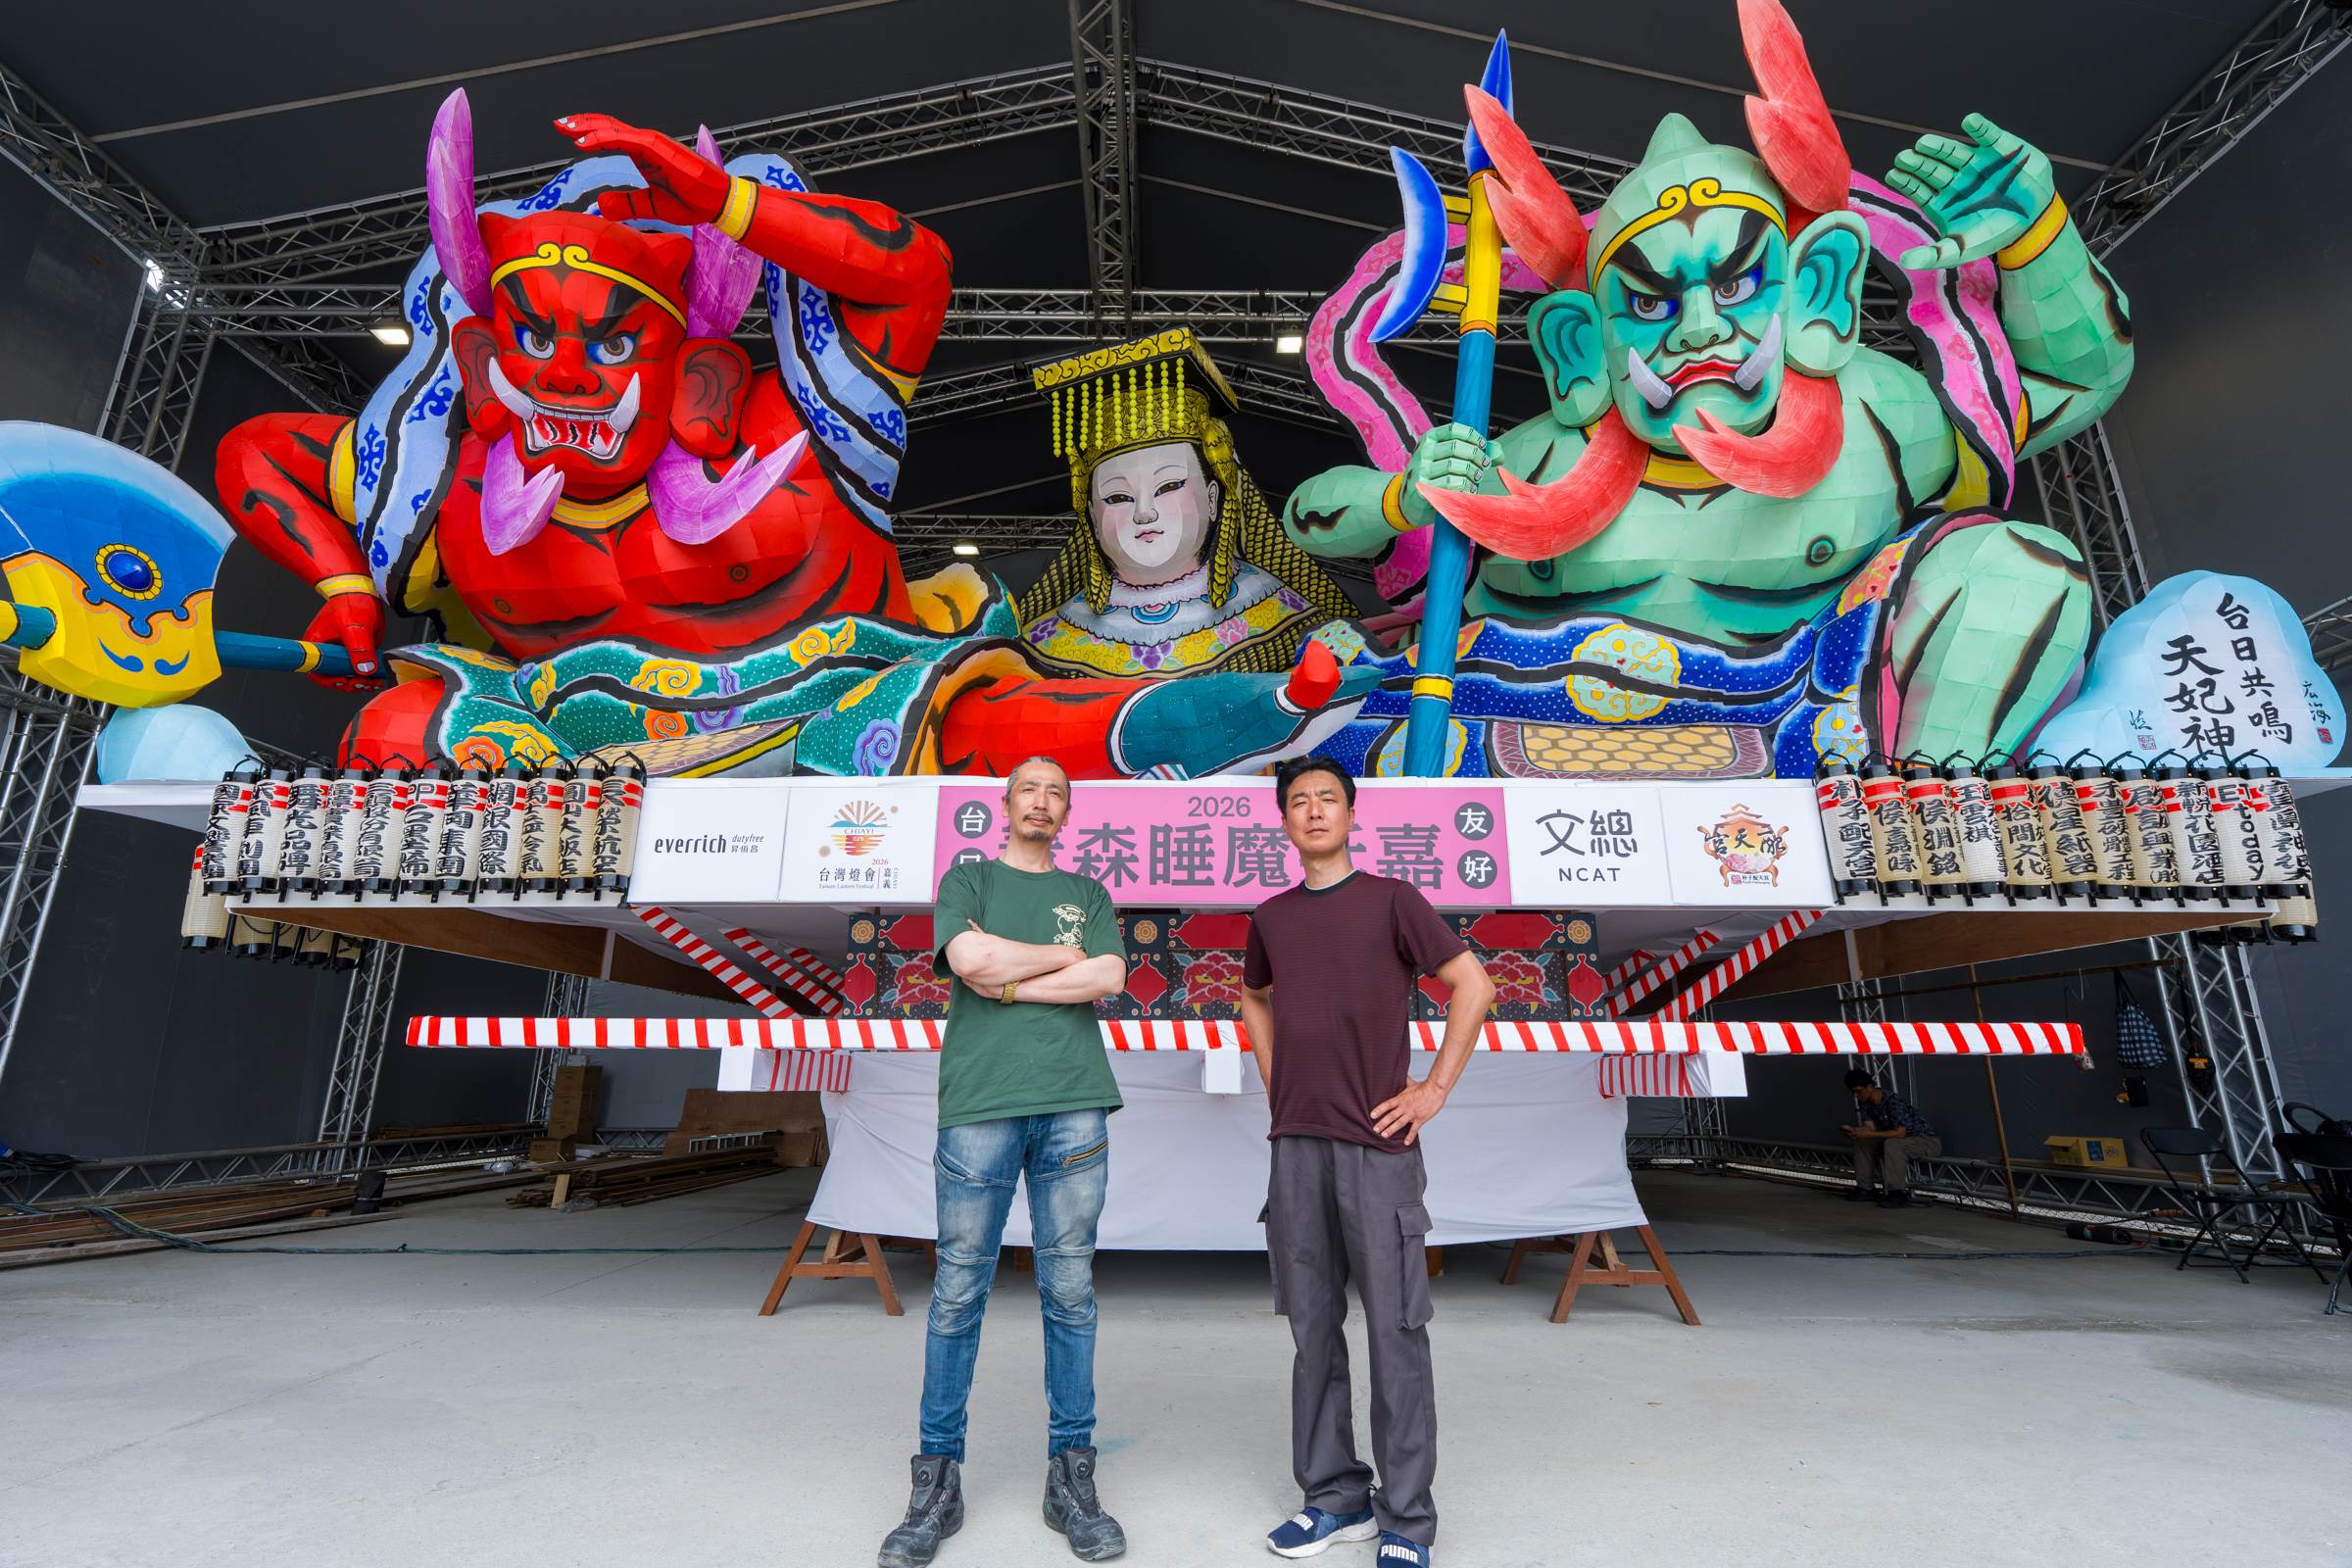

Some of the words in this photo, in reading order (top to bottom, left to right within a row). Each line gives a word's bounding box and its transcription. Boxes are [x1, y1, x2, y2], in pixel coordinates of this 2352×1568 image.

[2161, 634, 2234, 766] 天妃神
[2216, 592, 2291, 745] 台日共鳴
[560, 782, 587, 876] 圓山大飯店
[593, 779, 627, 874] 長榮航空
[1188, 796, 1251, 817] 2026
[1535, 808, 1639, 858] 文總
[1831, 778, 1878, 878] 朴子配天宮
[2217, 782, 2265, 882] ETtoday
[654, 834, 727, 854] everrich
[732, 833, 765, 844] dutyfree
[819, 867, 876, 882] 台灣燈會
[998, 822, 1445, 890] 森睡魔嘉
[1459, 808, 1493, 884] 友好
[1557, 866, 1621, 883] NCAT
[1381, 1544, 1419, 1564] PUMA
